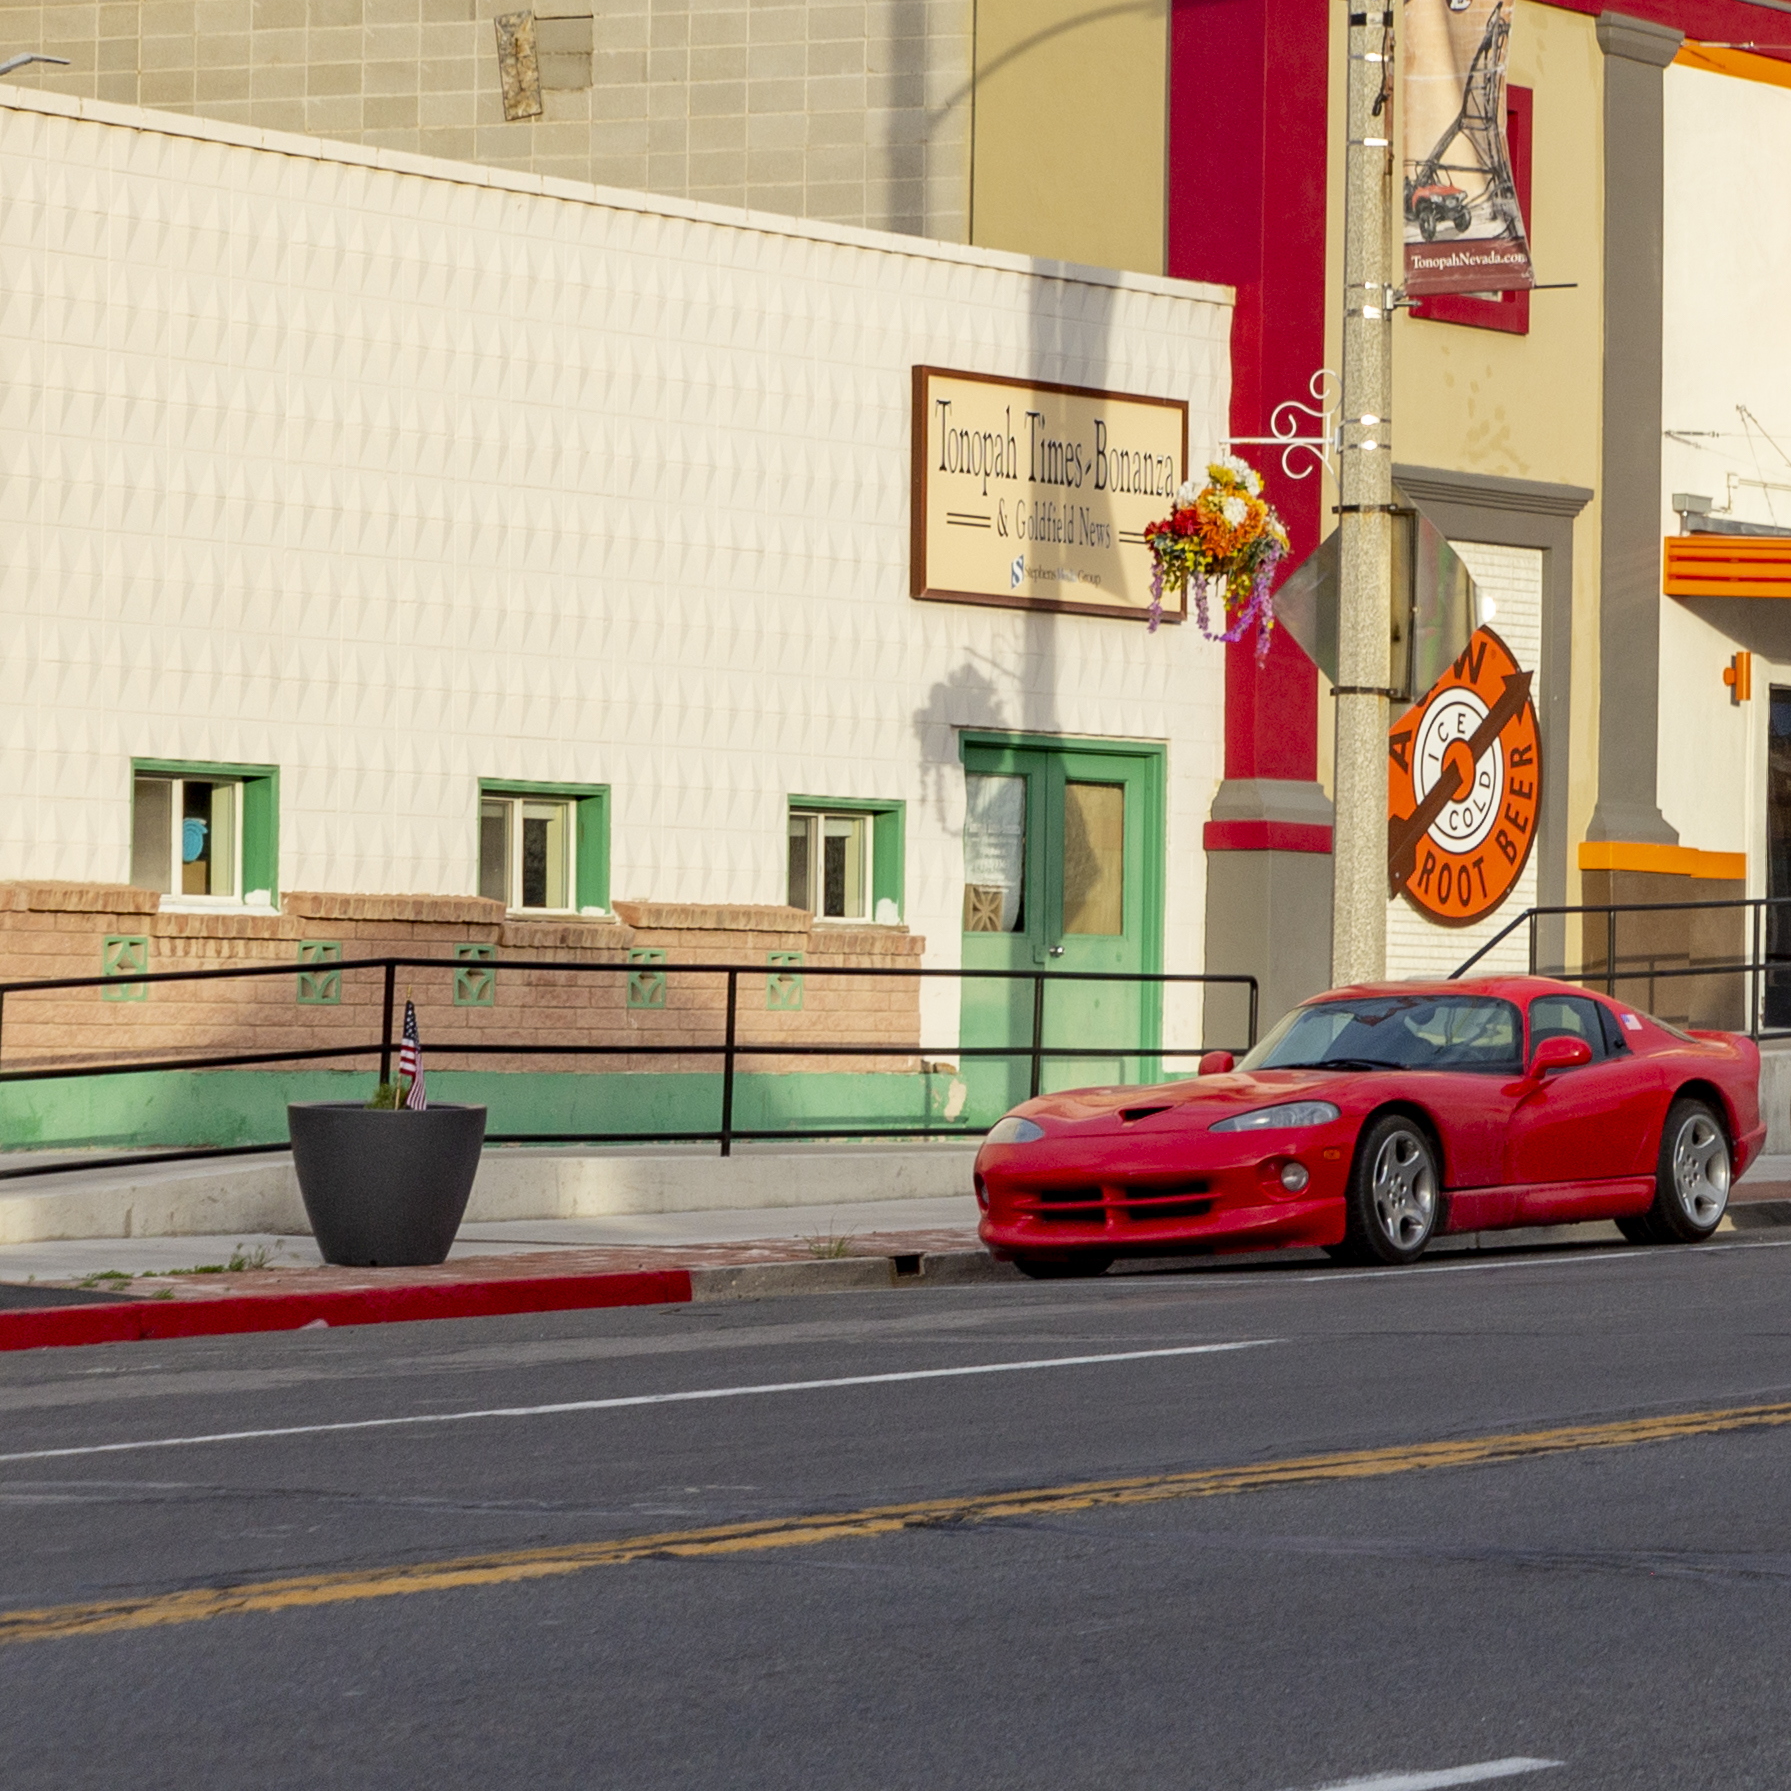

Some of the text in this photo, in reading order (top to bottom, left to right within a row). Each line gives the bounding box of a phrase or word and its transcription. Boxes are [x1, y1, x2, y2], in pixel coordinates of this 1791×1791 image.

[935, 400, 1018, 496] Tonopah
[997, 498, 1111, 549] & Goldfield News
[1428, 712, 1466, 762] ICE
[1449, 770, 1491, 831] COLD
[1495, 742, 1533, 864] BEER
[1417, 849, 1487, 907] ROOT
